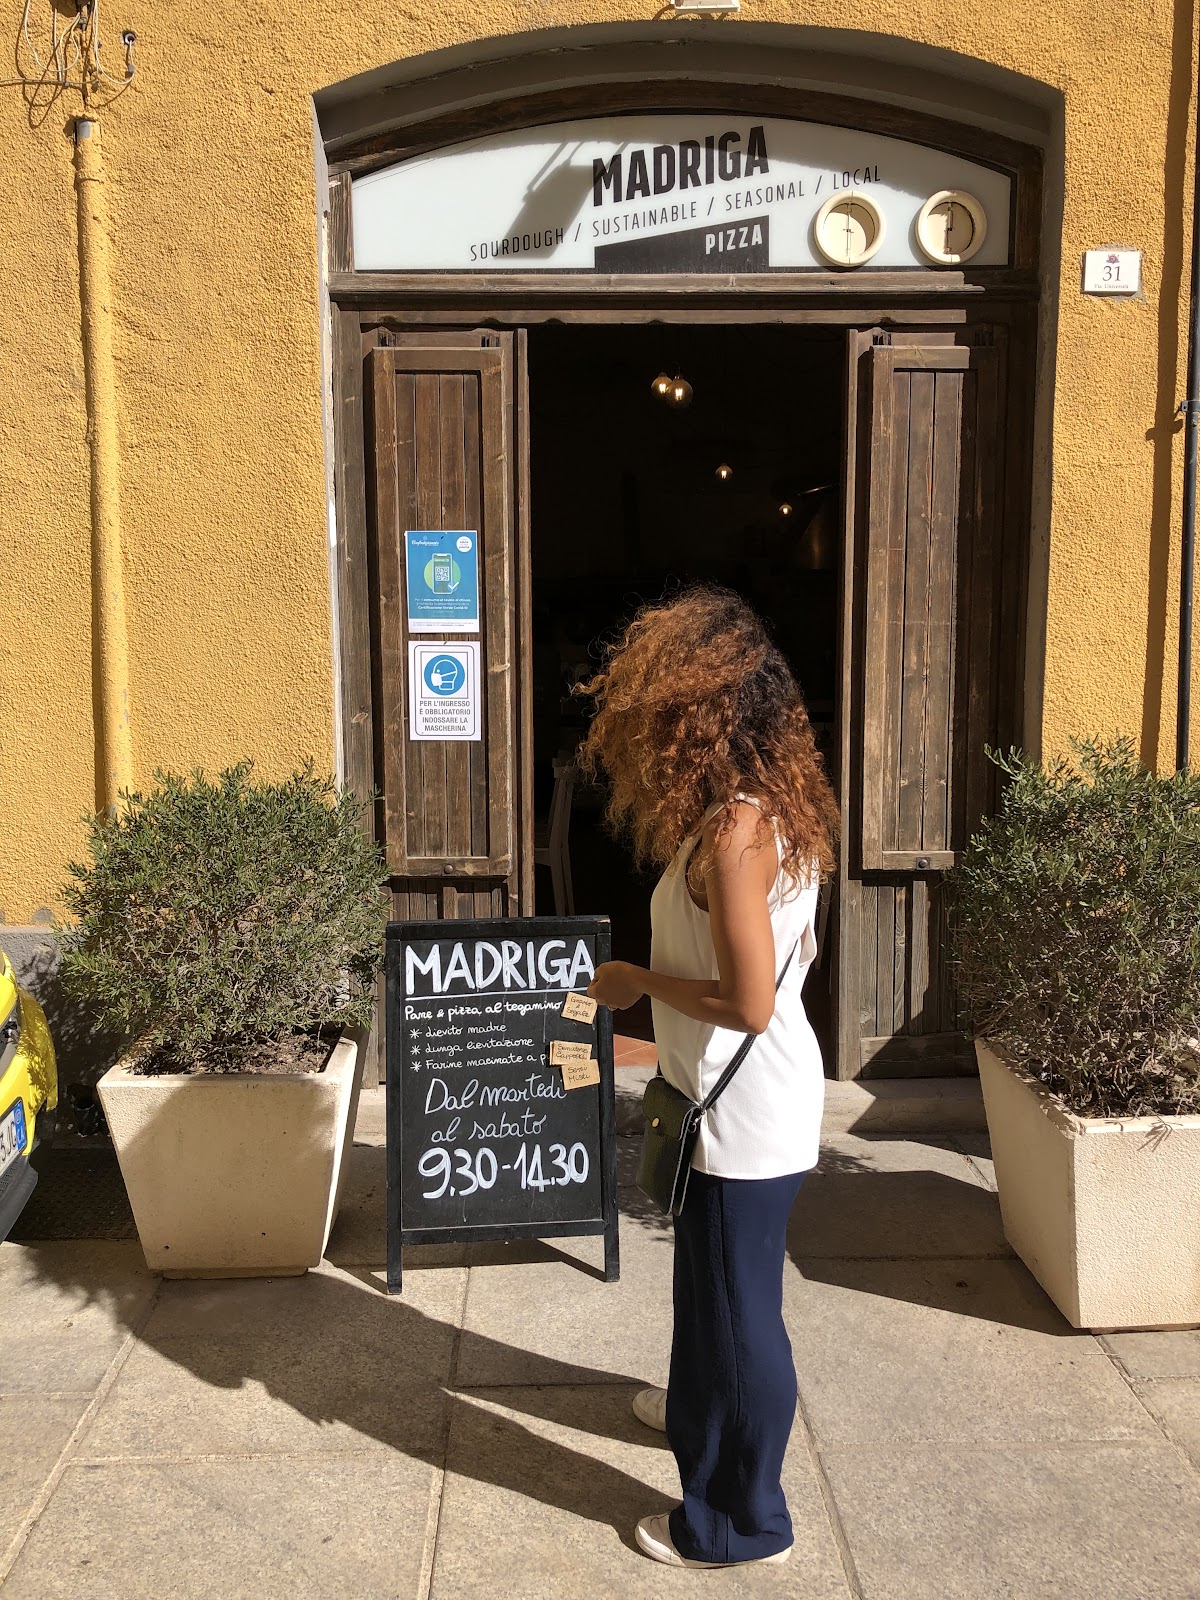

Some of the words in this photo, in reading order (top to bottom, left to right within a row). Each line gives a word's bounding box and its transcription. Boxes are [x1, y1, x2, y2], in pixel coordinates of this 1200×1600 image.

[593, 125, 769, 207] MADRIGA
[470, 230, 565, 262] SOURDOUGH
[592, 201, 698, 238] SUSTAINABLE
[725, 180, 805, 209] SEASONAL
[833, 165, 880, 191] LOCAL
[705, 224, 764, 255] PIZZA
[1102, 265, 1121, 282] 31
[405, 939, 595, 995] MADRIGA
[405, 1006, 432, 1021] Pane
[448, 1005, 482, 1022] pizza
[485, 1002, 502, 1013] al
[505, 1000, 563, 1016] tegamino
[467, 1021, 507, 1034] madre
[466, 1038, 535, 1050] lievitazione
[425, 1059, 463, 1070] Farine
[466, 1052, 523, 1067] macinate
[424, 1077, 479, 1114] Dal
[431, 1117, 461, 1143] al
[467, 1106, 547, 1141] sabato
